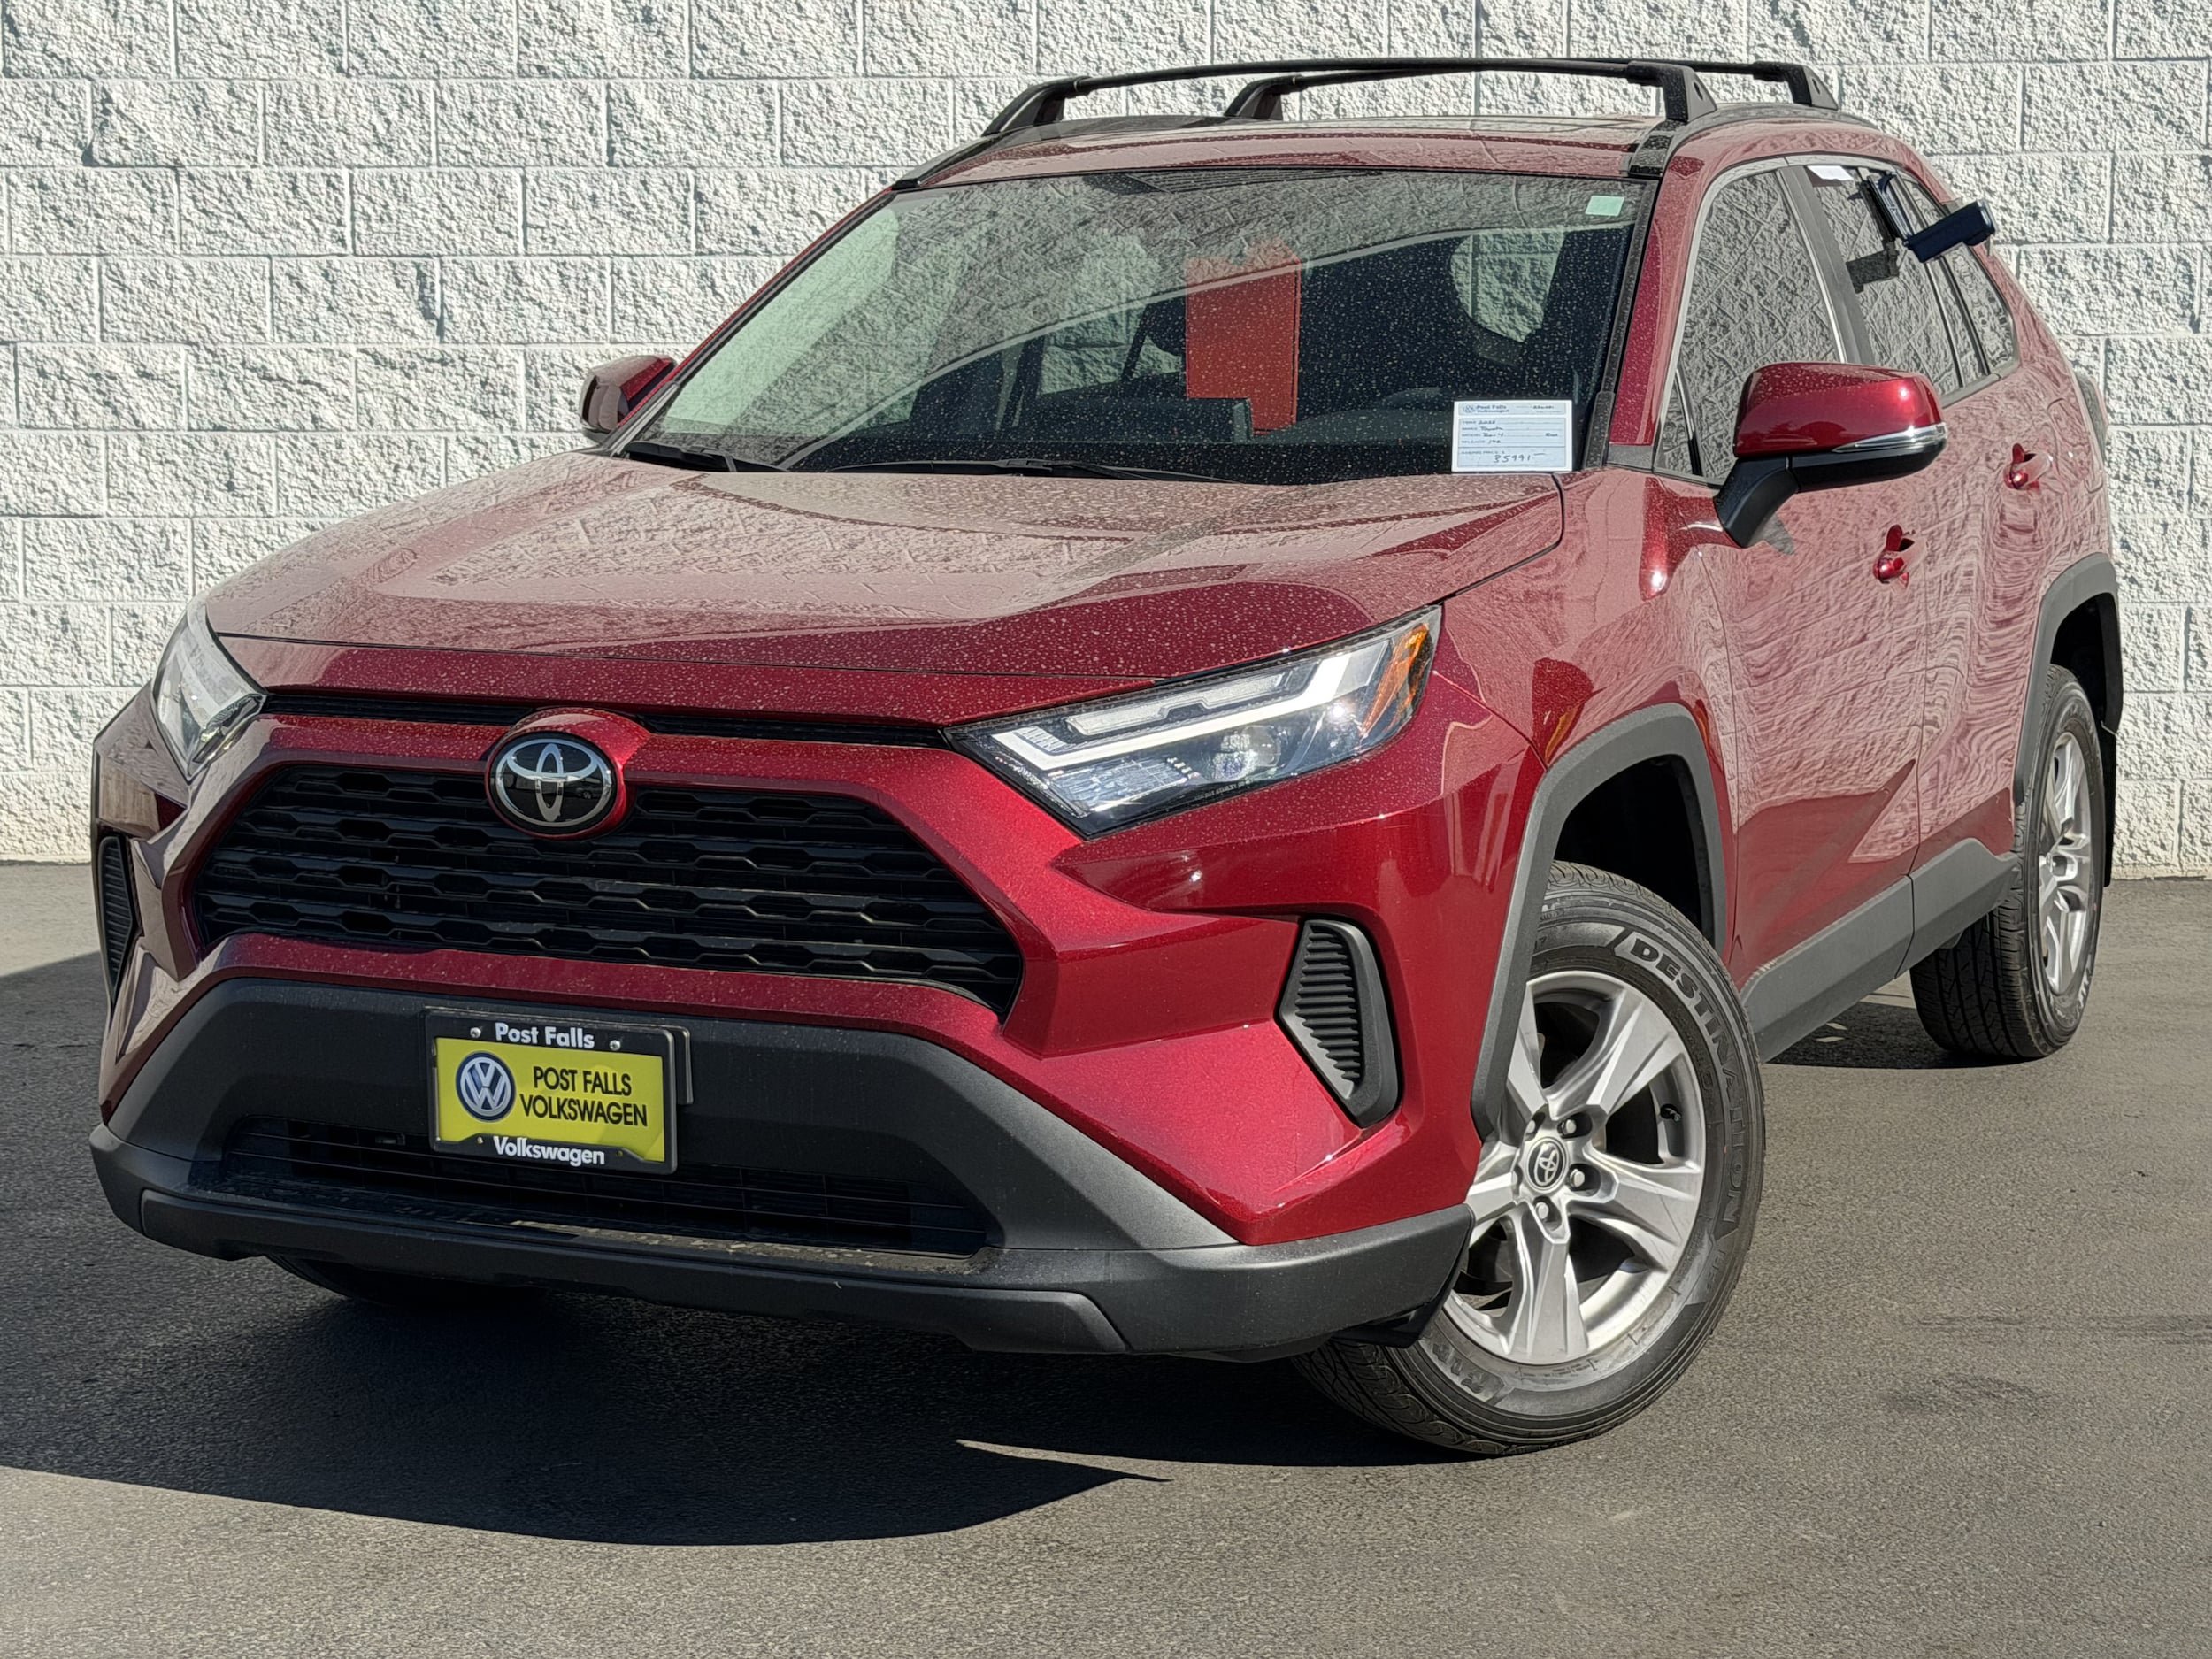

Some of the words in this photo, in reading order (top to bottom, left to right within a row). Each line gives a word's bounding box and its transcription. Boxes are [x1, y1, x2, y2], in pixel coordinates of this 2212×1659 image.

[495, 1022, 539, 1045] Post
[545, 1026, 595, 1049] Falls
[533, 1066, 578, 1091] POST
[583, 1070, 632, 1096] FALLS
[1630, 938, 1746, 1223] DESTINATION
[520, 1094, 648, 1127] VOLKSWAGEN
[493, 1136, 605, 1166] Volkswagen
